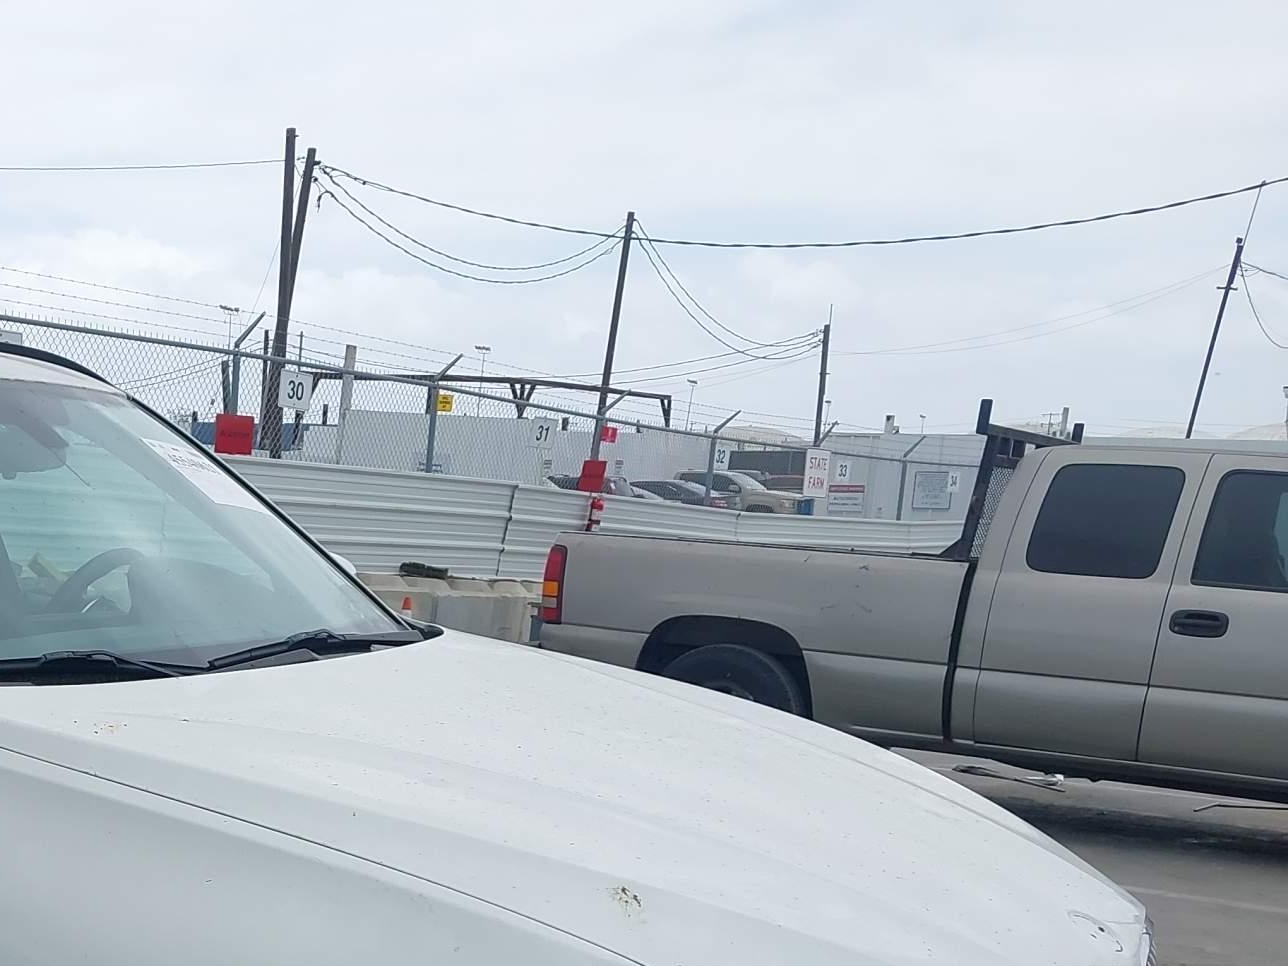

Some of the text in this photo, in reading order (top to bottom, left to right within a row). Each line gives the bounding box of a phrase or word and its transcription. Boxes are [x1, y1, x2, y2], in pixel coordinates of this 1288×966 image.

[287, 380, 304, 401] 30
[535, 425, 550, 442] 31
[715, 449, 726, 464] 32
[809, 456, 828, 471] STATE
[838, 464, 848, 478] 33
[807, 476, 825, 489] FARM
